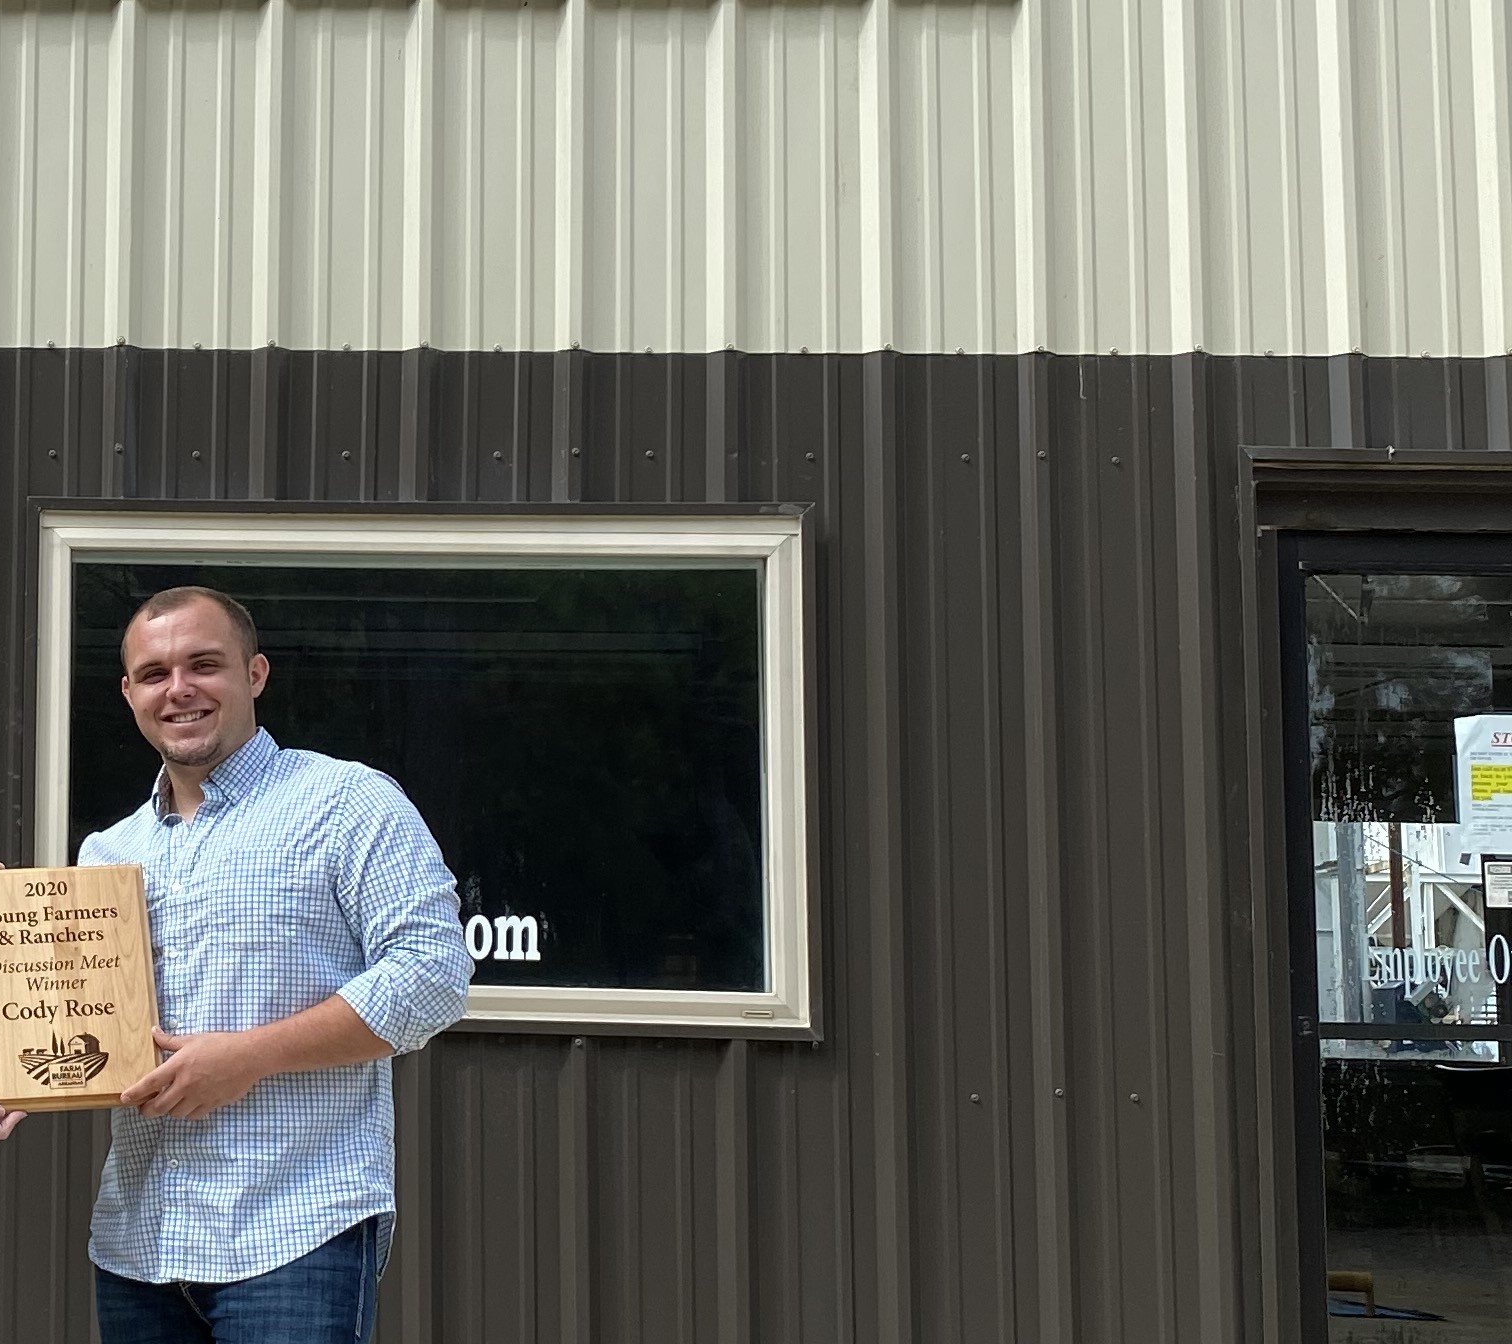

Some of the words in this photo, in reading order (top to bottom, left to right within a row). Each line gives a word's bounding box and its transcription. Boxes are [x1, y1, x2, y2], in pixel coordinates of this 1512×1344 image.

[1491, 732, 1512, 744] ST
[24, 881, 68, 897] 2020
[43, 905, 118, 922] Farmers
[20, 926, 104, 945] Ranchers
[80, 954, 121, 970] Meet
[1361, 934, 1481, 999] Employee
[26, 976, 88, 992] Winner
[1, 1001, 59, 1024] Cody
[64, 999, 116, 1018] Rose
[59, 1065, 82, 1073] FARM
